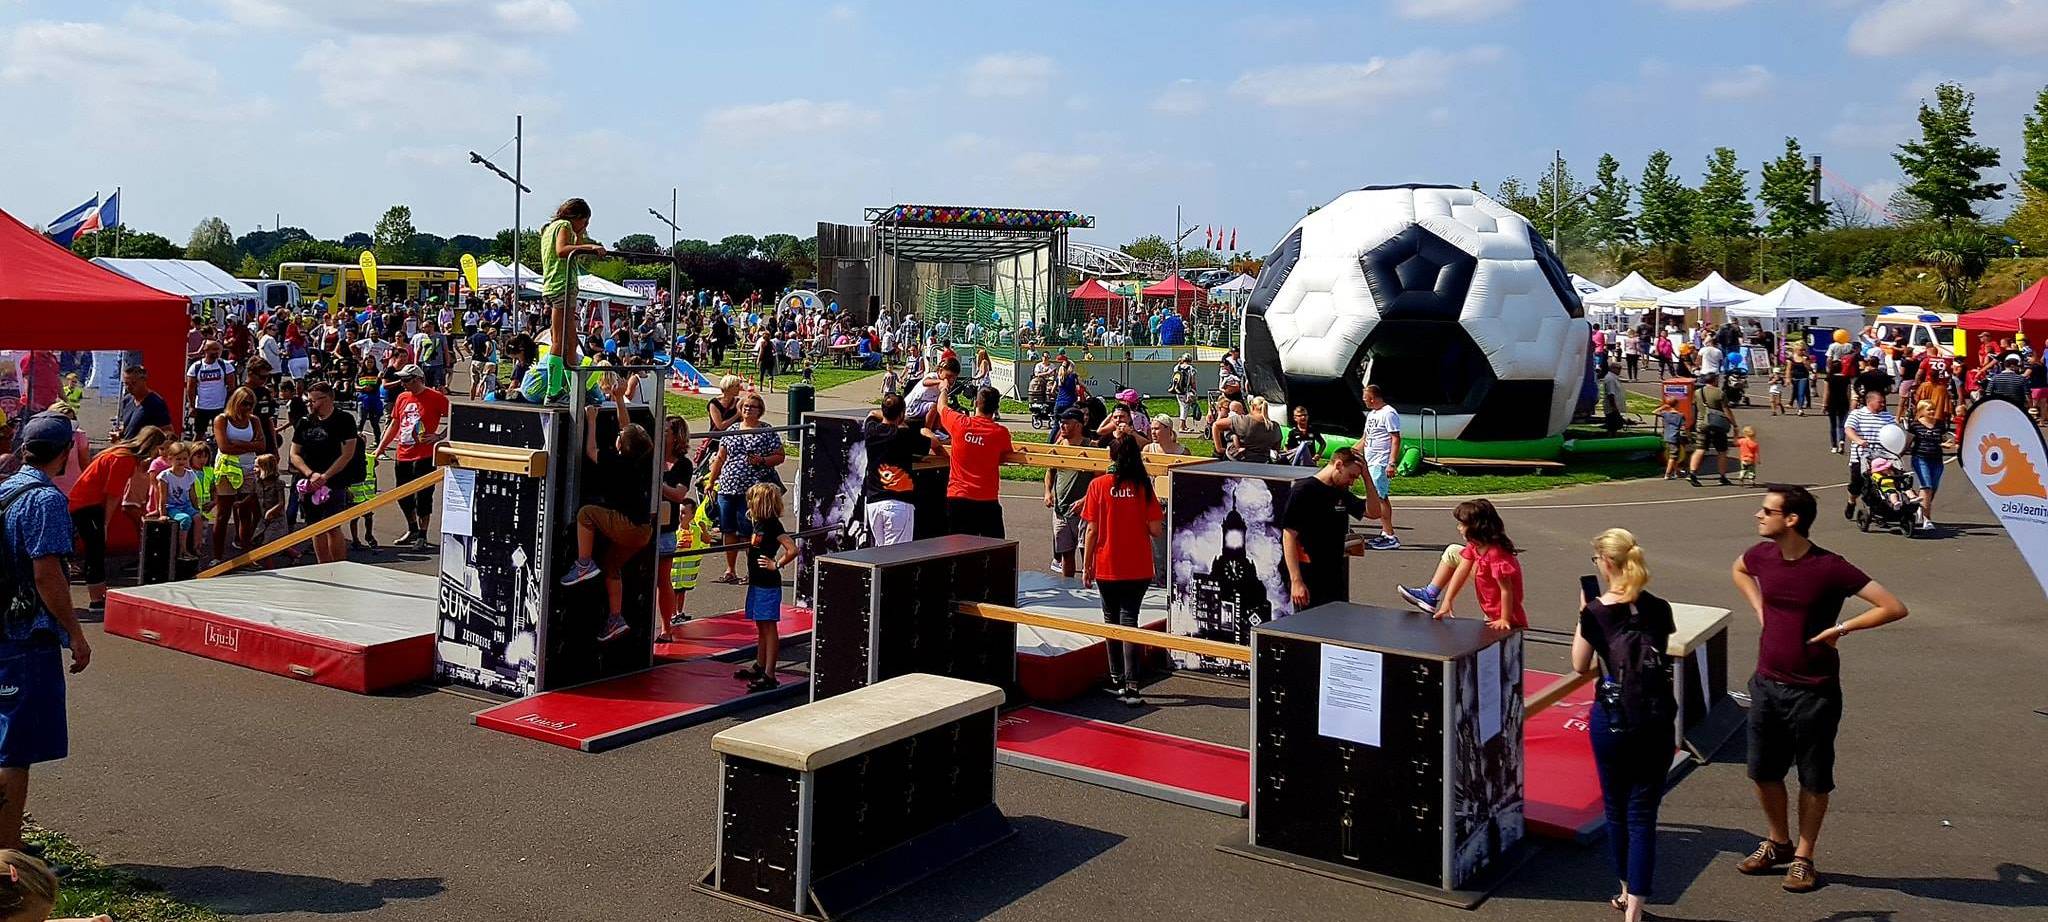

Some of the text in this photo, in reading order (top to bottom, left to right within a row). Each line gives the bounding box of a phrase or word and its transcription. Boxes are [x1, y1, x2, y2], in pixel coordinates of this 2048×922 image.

[964, 431, 985, 446] Gut.
[1110, 486, 1135, 498] Gut.
[440, 586, 471, 625] SUM
[462, 628, 492, 650] ZEITREISE
